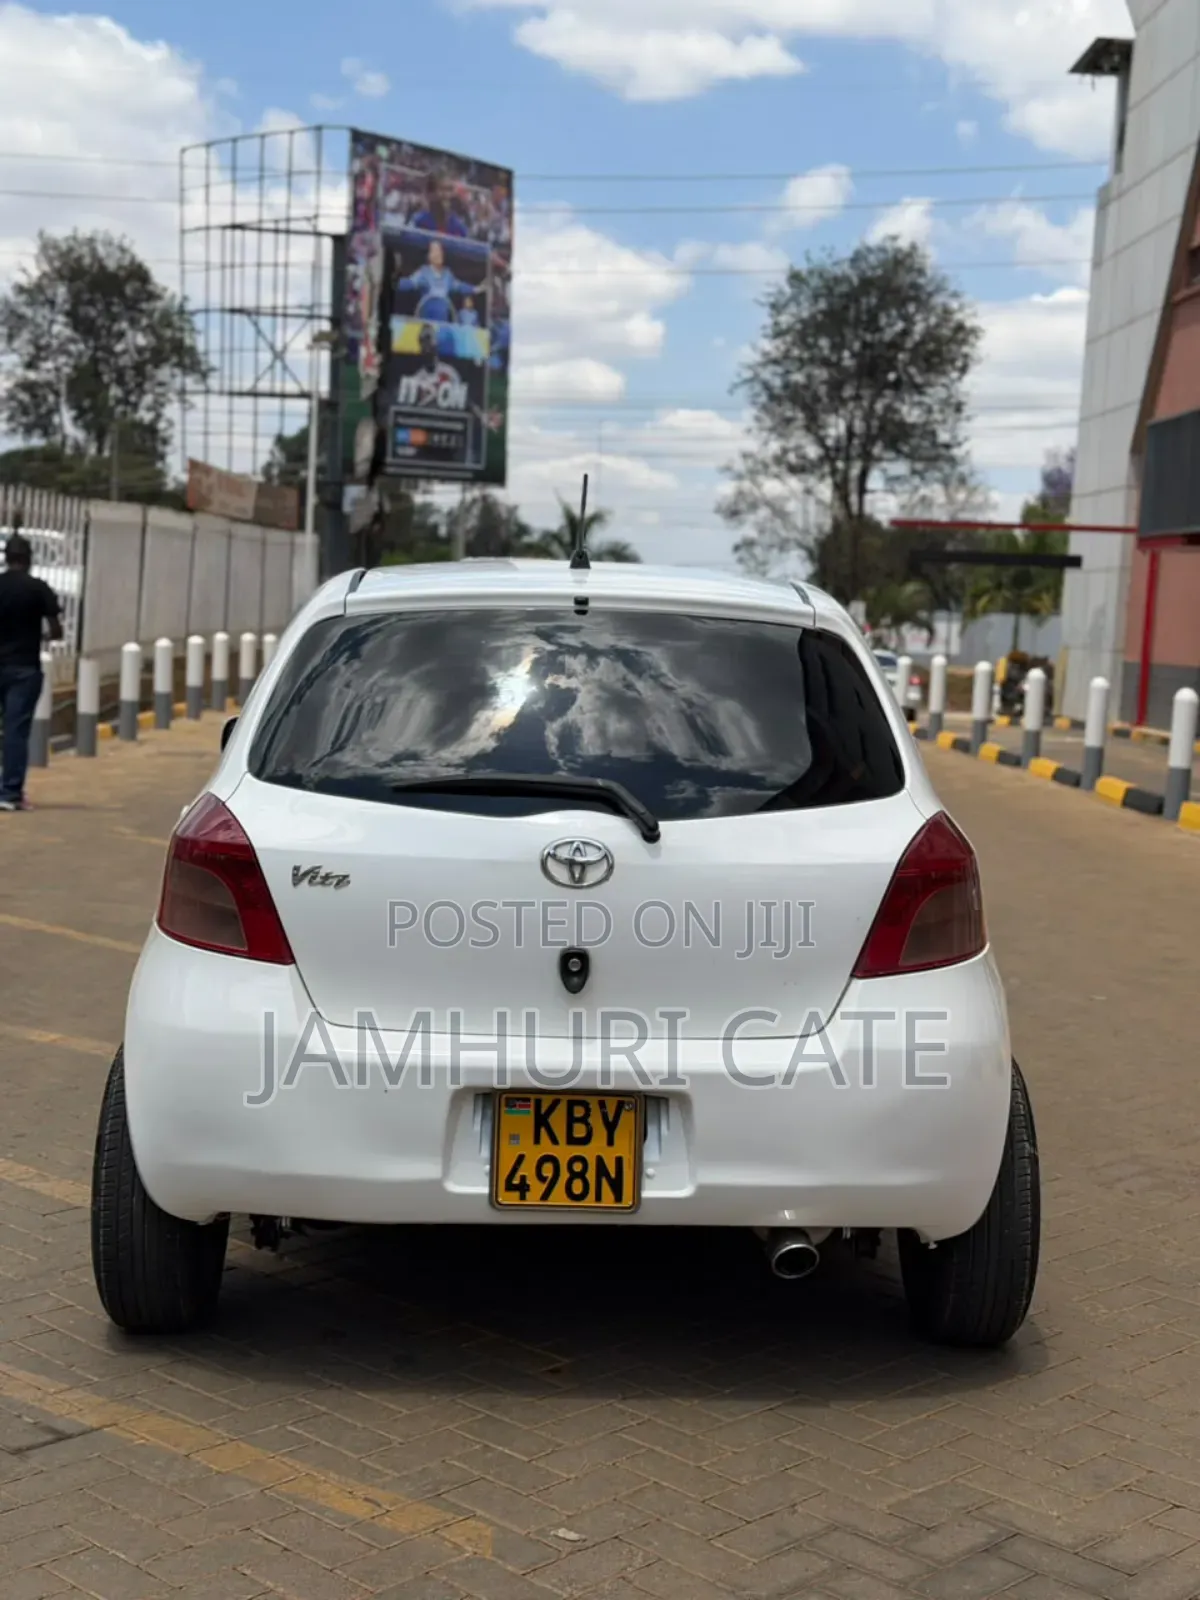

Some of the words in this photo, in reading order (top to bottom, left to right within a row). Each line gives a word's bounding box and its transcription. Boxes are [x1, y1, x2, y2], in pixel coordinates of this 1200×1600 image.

[291, 864, 351, 890] Vitz
[532, 1098, 626, 1147] KBY
[504, 1153, 624, 1203] 498N
